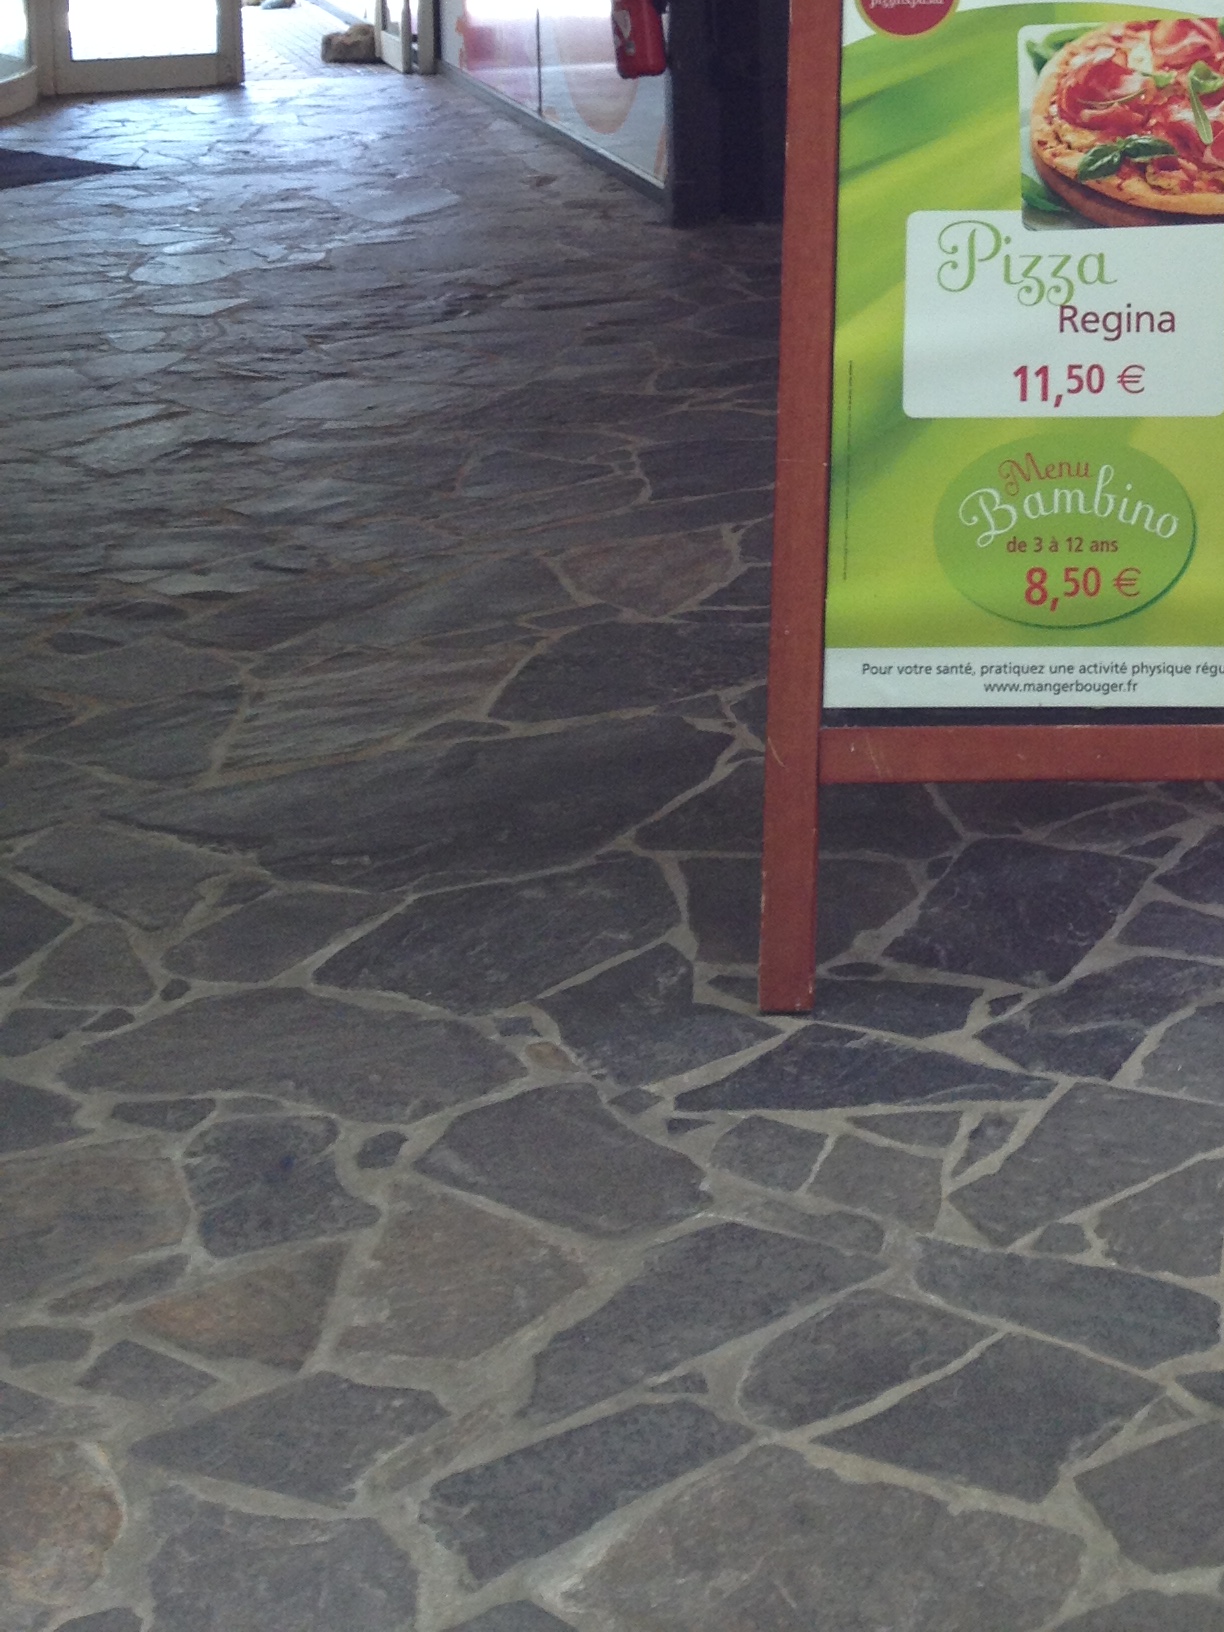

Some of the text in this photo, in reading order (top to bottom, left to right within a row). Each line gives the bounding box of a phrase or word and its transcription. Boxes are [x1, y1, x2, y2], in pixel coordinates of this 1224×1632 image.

[937, 219, 1118, 307] Pizza
[1058, 303, 1177, 343] Regina
[1012, 362, 1146, 408] 11,50 €
[997, 451, 1092, 496] Menu
[957, 463, 1180, 548] Bambino
[1005, 535, 1120, 554] de 3 à 12 ans
[1024, 566, 1143, 613] 8,50 €
[861, 662, 894, 676] Pour
[897, 664, 933, 676] votre
[936, 662, 976, 678] santé,
[980, 662, 1046, 680] pratiquez
[1049, 664, 1075, 675] une
[1078, 662, 1128, 676] activité
[1131, 661, 1192, 680] physique
[983, 679, 1139, 697] www.mangerbouger.fr
